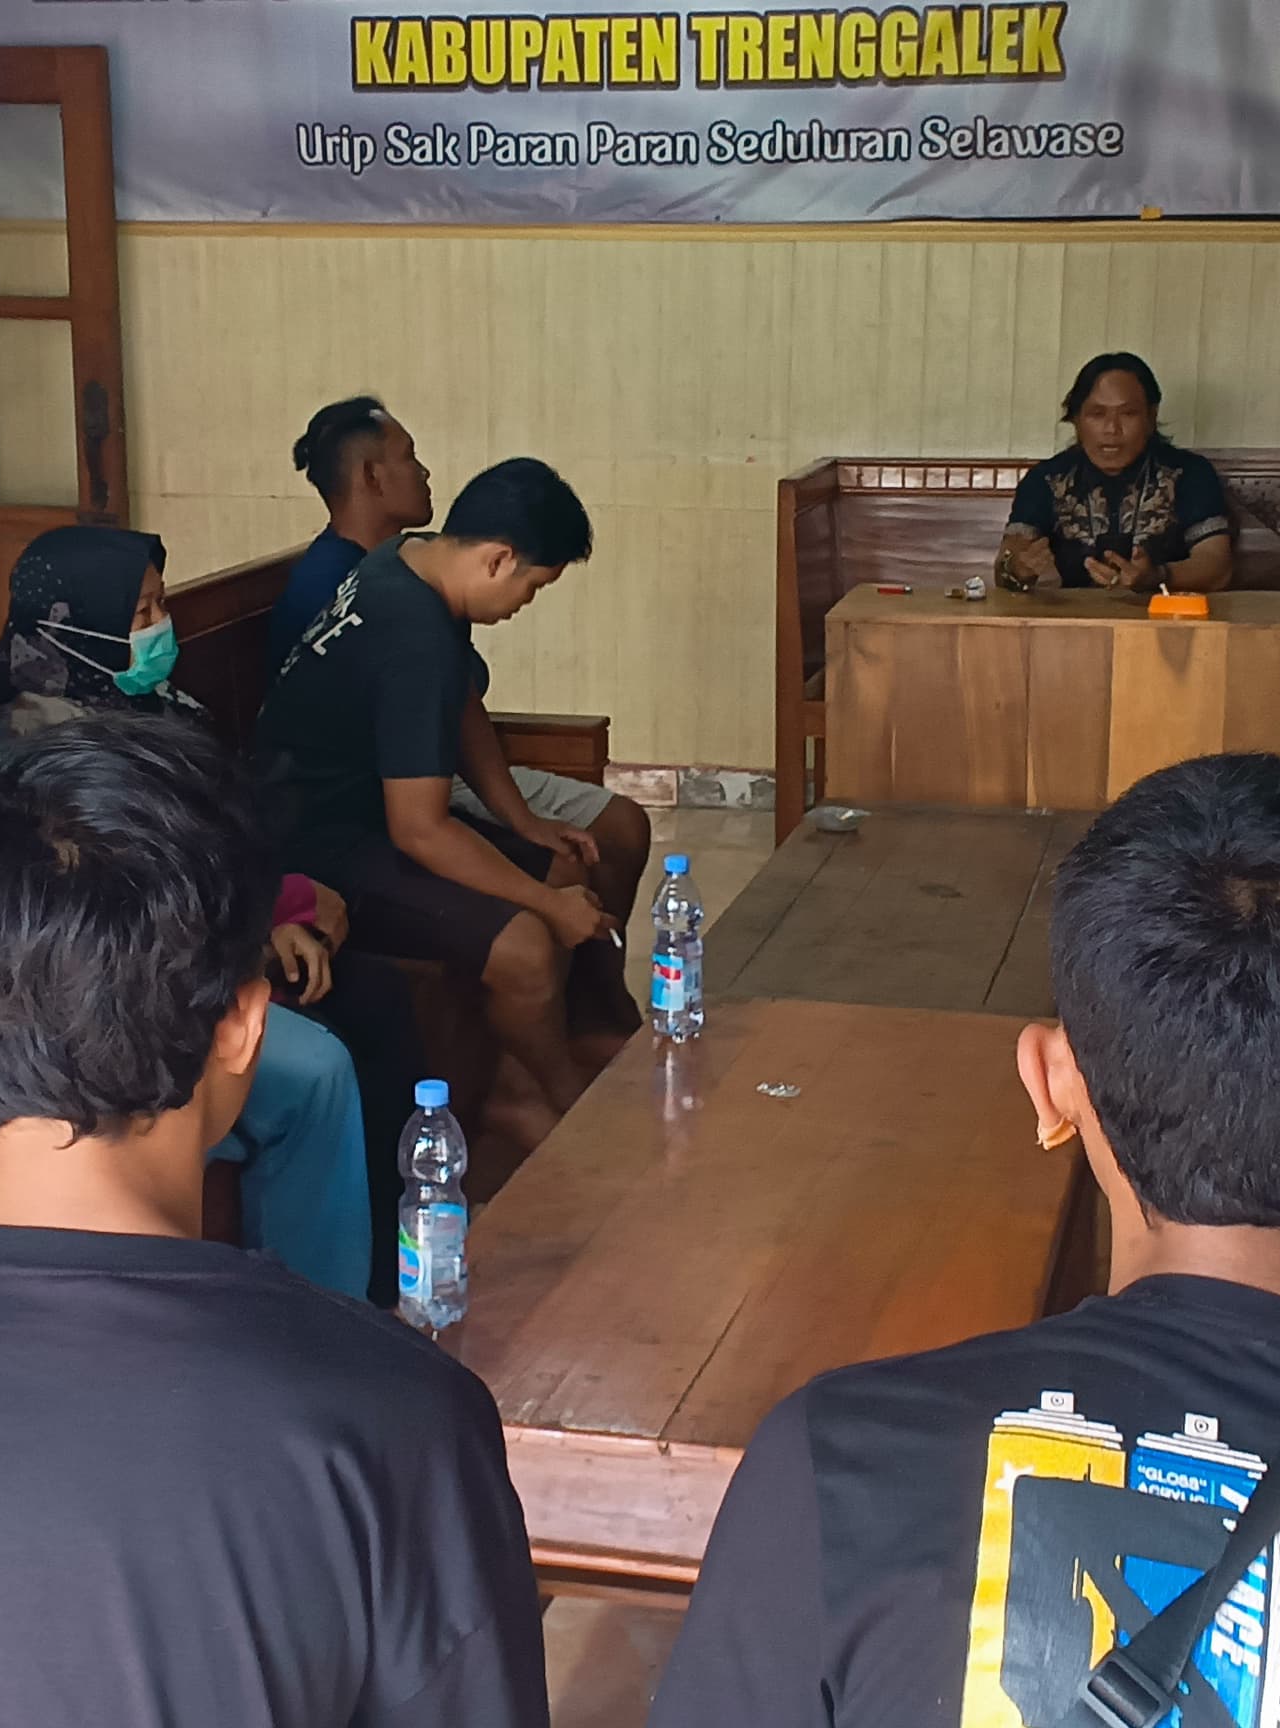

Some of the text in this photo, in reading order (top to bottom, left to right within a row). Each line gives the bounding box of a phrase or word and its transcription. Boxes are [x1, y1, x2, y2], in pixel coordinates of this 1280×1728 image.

[353, 4, 1068, 90] KABUPATEN TRENGGALEK
[297, 115, 1123, 175] Urip Sak Paran Paran Seduluran Selawase
